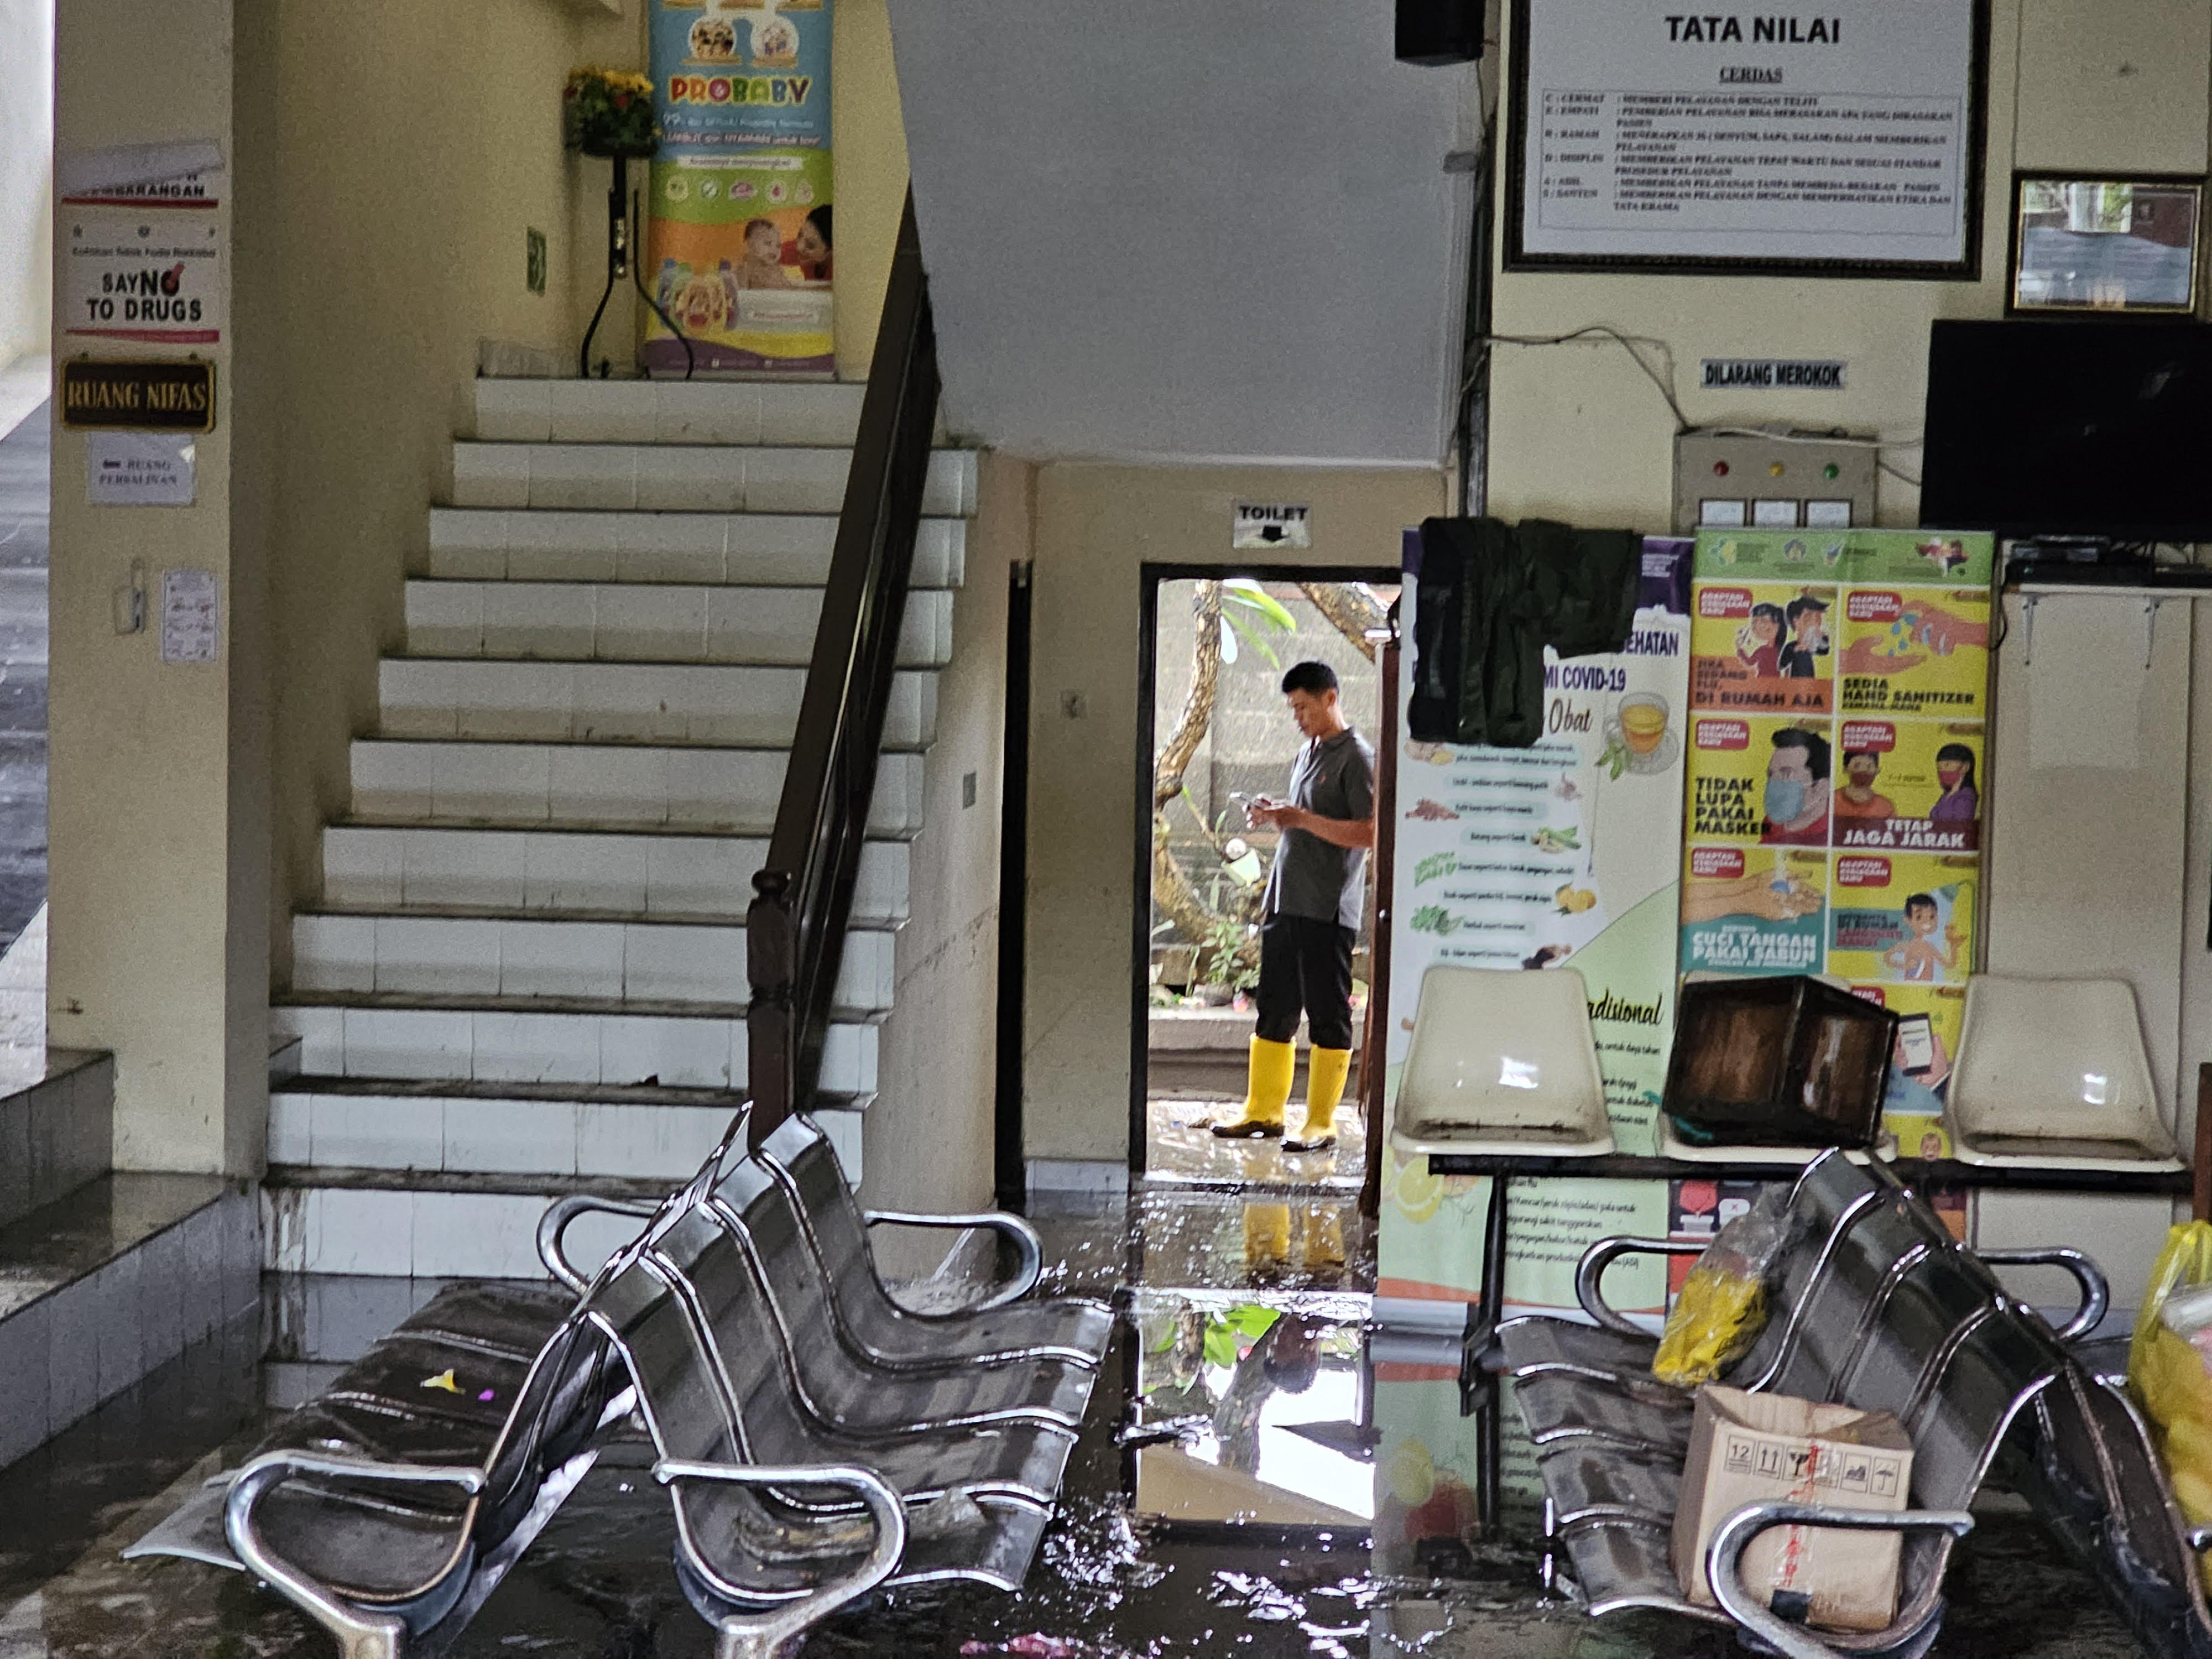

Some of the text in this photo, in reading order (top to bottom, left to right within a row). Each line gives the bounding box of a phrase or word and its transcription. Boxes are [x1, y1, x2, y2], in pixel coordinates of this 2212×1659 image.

[1665, 15, 1841, 44] TATA NILAI
[1720, 66, 1782, 82] CERDAS
[86, 299, 202, 322] TO DRUGS
[1776, 365, 1841, 386] MEROKOK
[67, 380, 207, 410] RUANG NIFAS
[1238, 505, 1308, 521] TOILET
[1563, 666, 1626, 691] COVID-19
[1720, 692, 1785, 706] RUMAH
[1843, 689, 1975, 705] HAND SANITIZER
[1550, 698, 1593, 734] Obat
[1695, 777, 1754, 792] TIDAK
[1696, 792, 1745, 806] LUPA
[1695, 807, 1754, 821] PAKAI
[1694, 820, 1771, 835] MASKER
[1886, 819, 1934, 832] TETAP
[1843, 830, 1965, 848] JAGA JARAK
[1693, 931, 1817, 948] CUCI TANGAN
[1693, 945, 1749, 960] PAKAI
[1588, 986, 1661, 1025] adisional
[1732, 1444, 1750, 1459] 12
